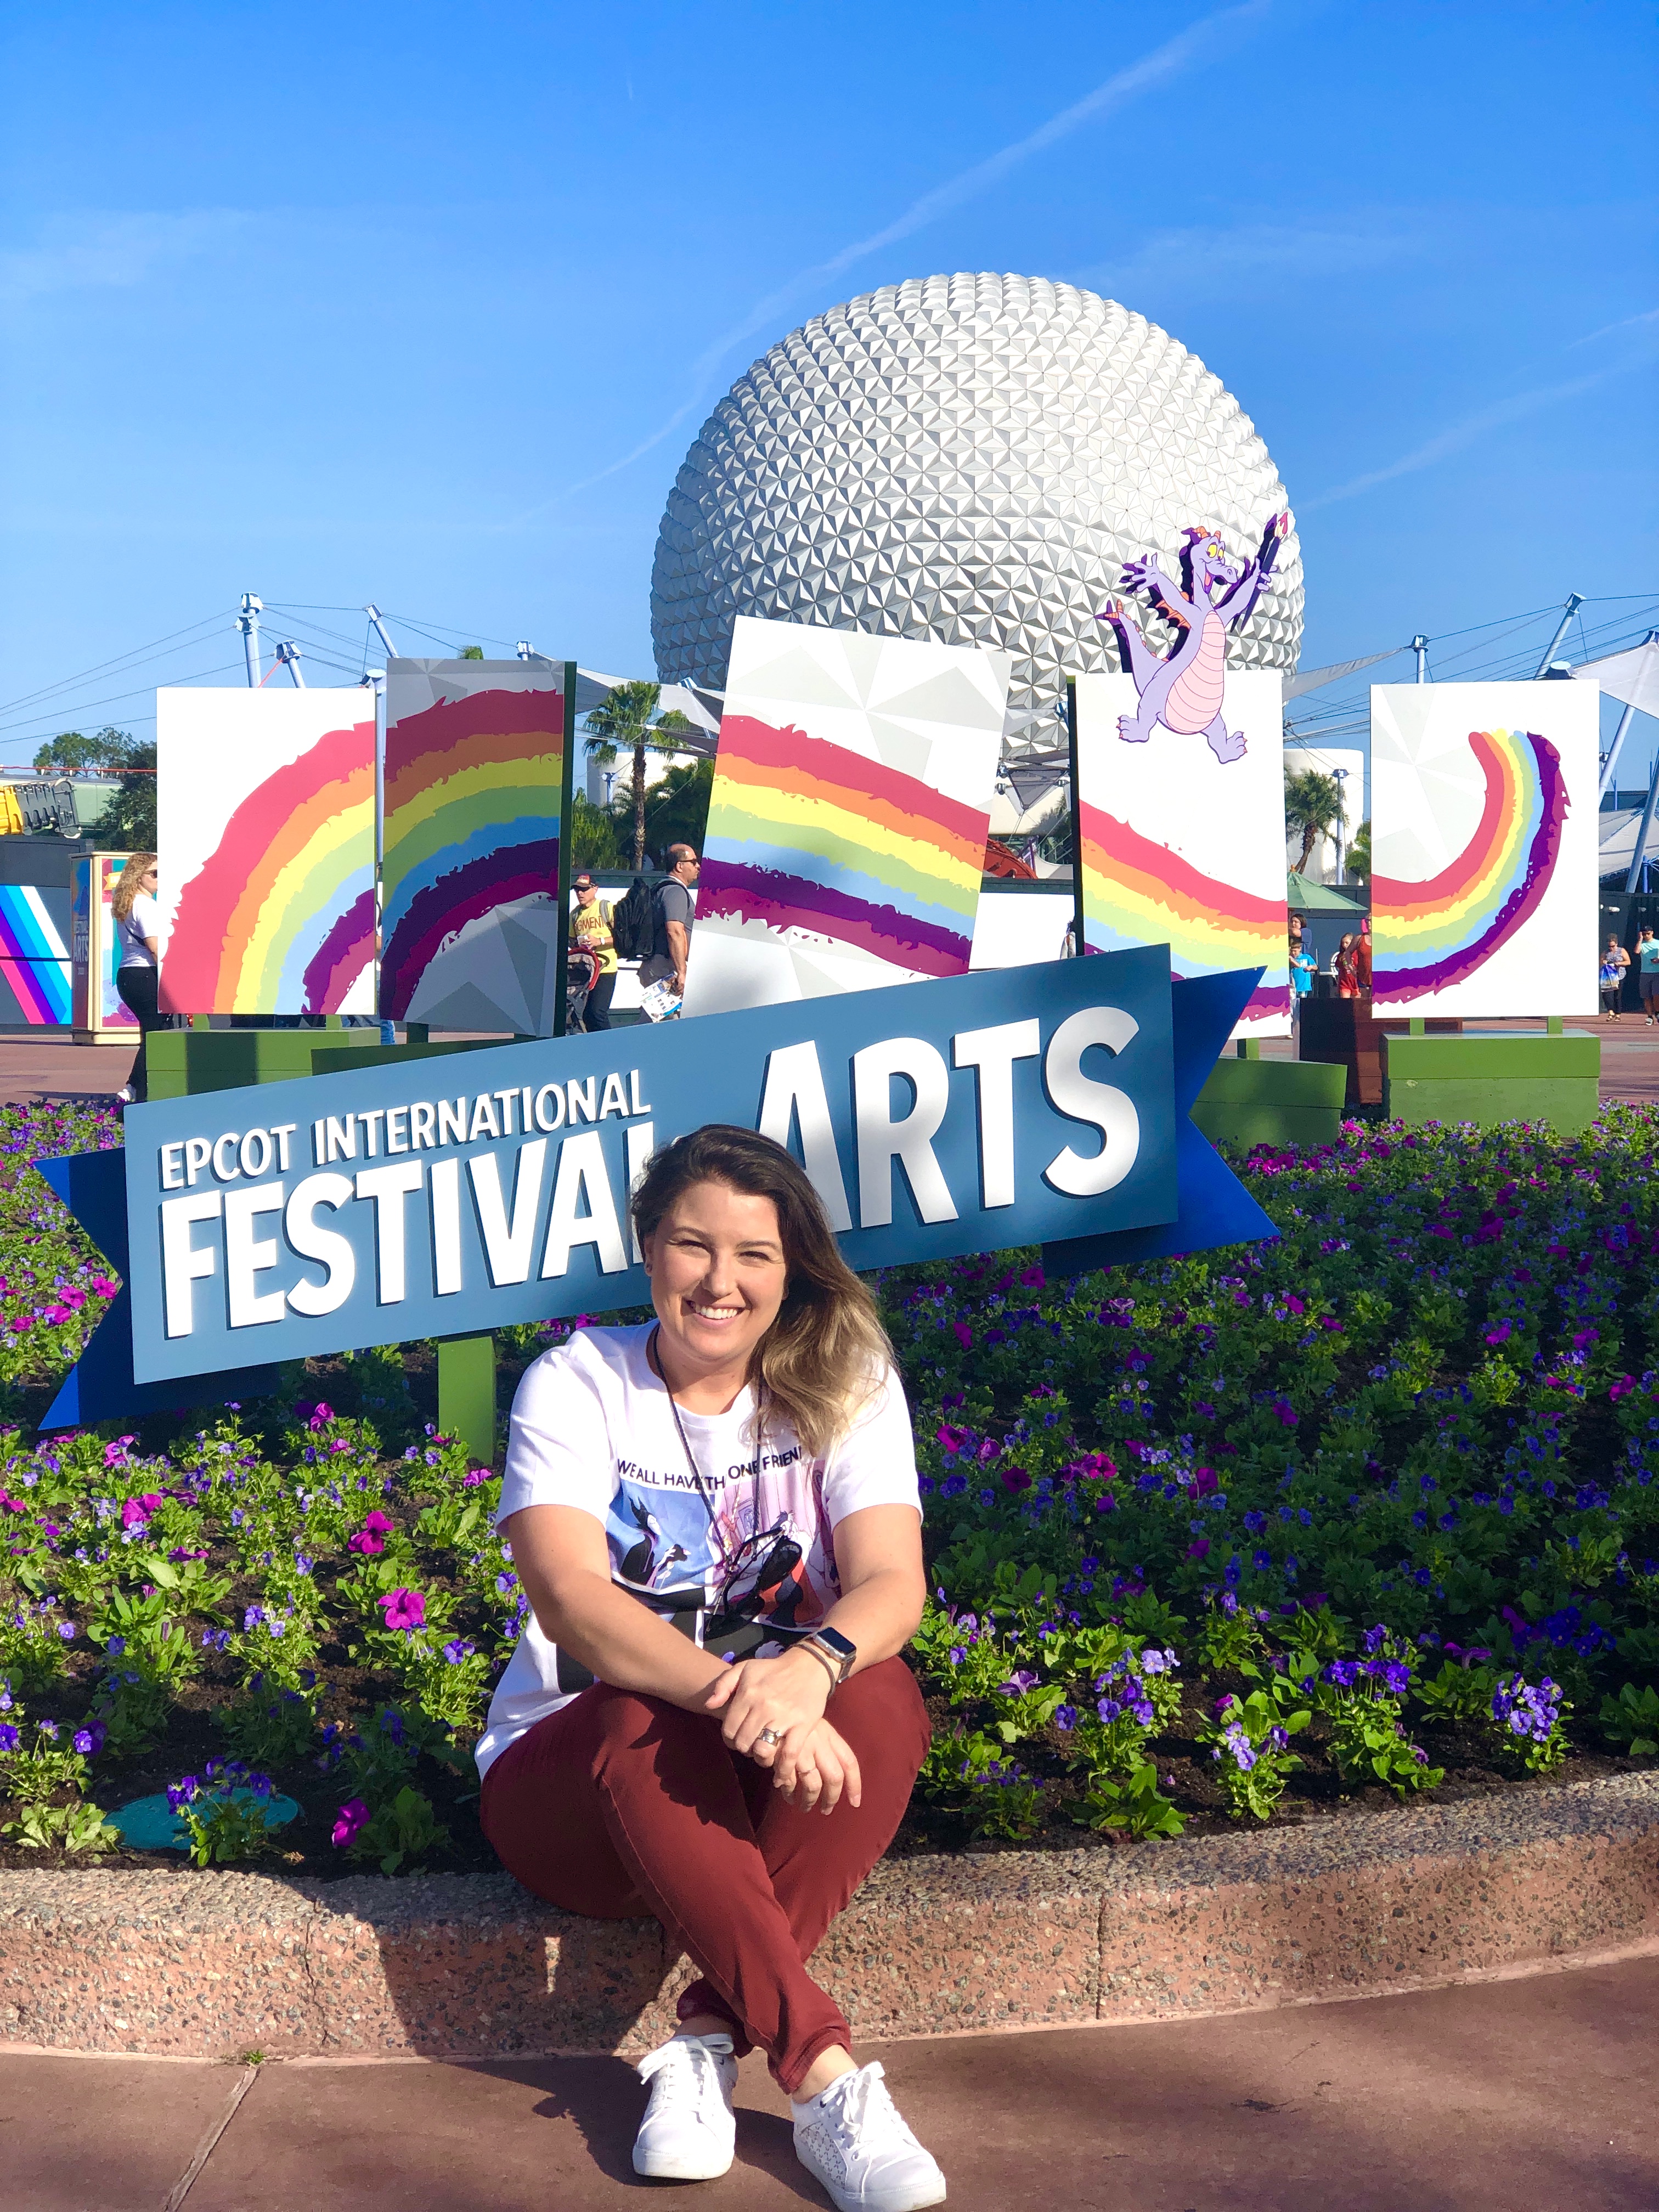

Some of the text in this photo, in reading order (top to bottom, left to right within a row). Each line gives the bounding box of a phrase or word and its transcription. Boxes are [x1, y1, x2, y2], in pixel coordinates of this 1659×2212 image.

[72, 934, 88, 963] ARTS
[160, 1068, 652, 1190] EPCOT INTERNATIONAL
[757, 1006, 1140, 1231] ARTS
[617, 1458, 637, 1478] WE
[636, 1468, 660, 1485] ALL
[762, 1445, 802, 1471] FRIEN
